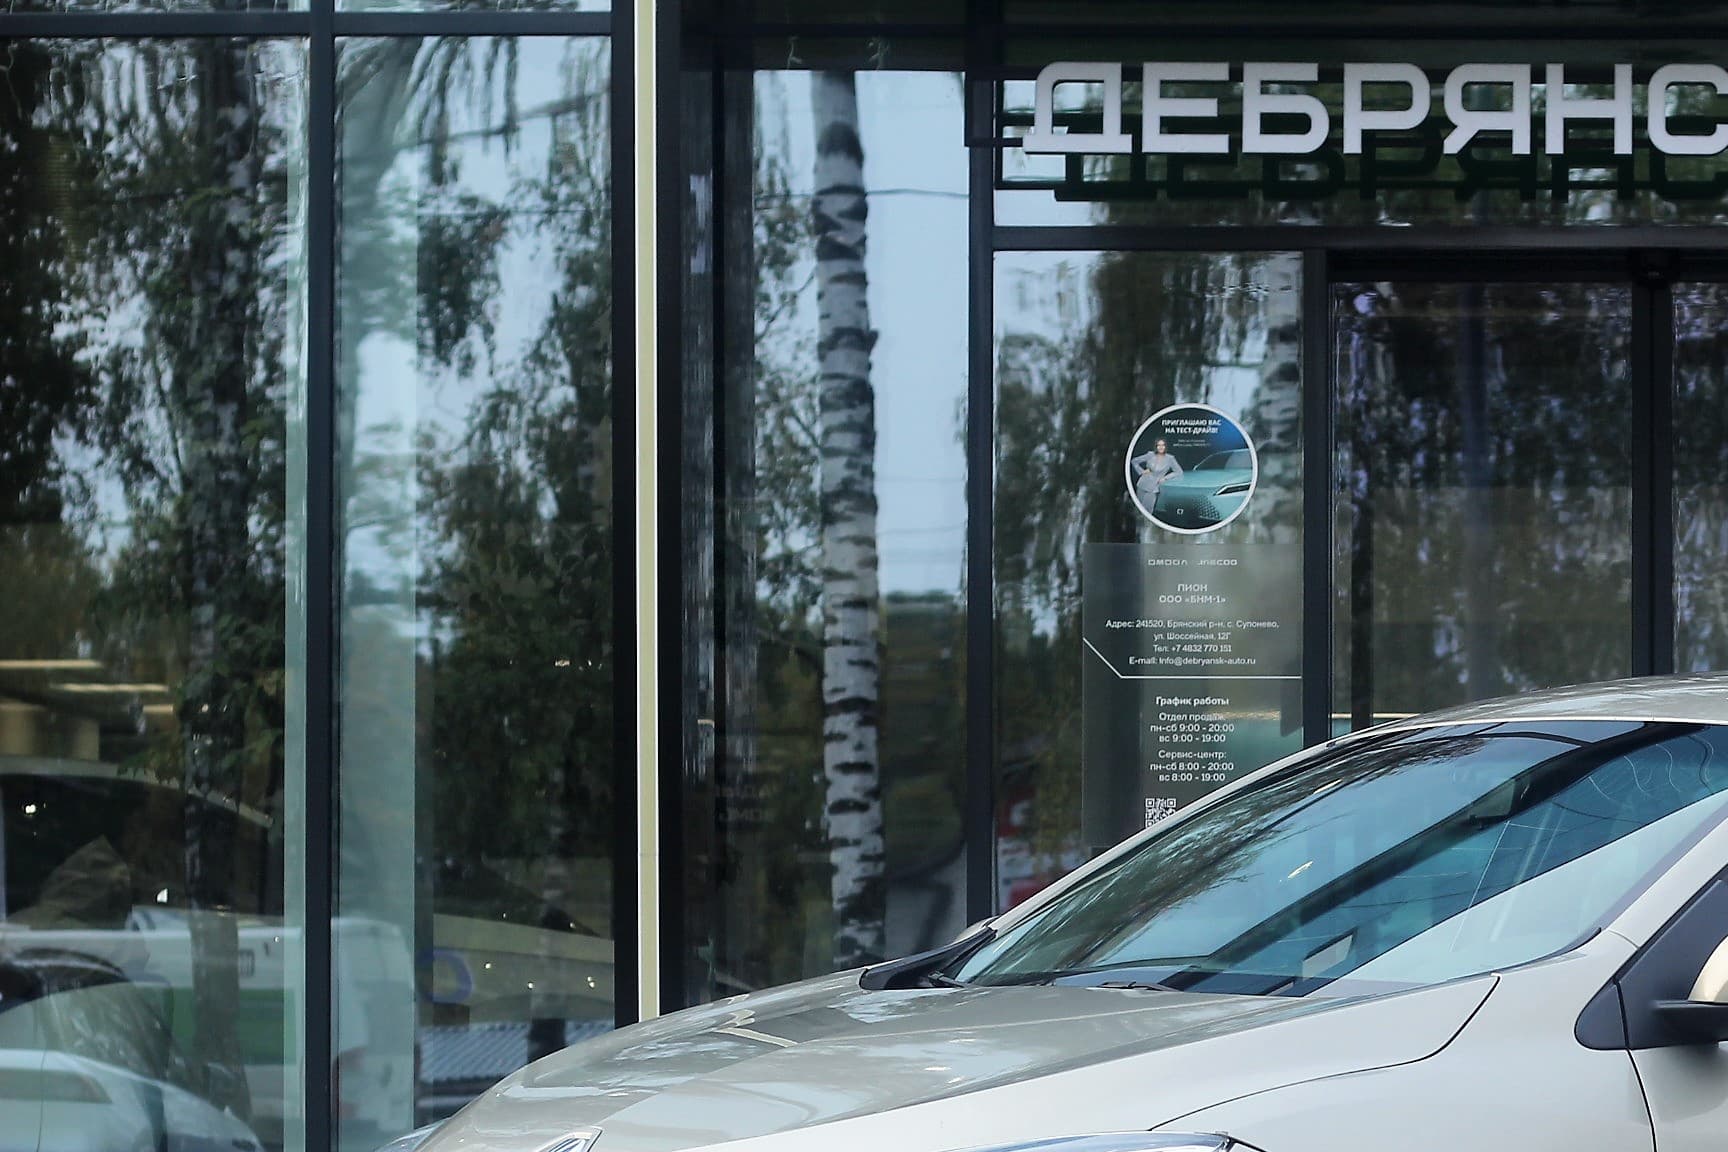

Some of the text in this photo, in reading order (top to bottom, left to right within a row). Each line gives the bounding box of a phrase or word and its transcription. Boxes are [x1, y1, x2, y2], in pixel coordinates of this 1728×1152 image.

[1159, 595, 1182, 603] ООО
[1106, 619, 1135, 629] Адрес:
[1167, 620, 1207, 629] Брянский
[1204, 644, 1218, 652] 770
[1220, 644, 1231, 652] 151
[1156, 696, 1229, 706] График работы
[1159, 712, 1187, 721] Отдел
[1150, 724, 1177, 732] пн-сб
[1179, 723, 1200, 732] 9:00
[1208, 723, 1234, 732] 20:00
[1172, 734, 1193, 742] 9:00
[1201, 734, 1226, 742] 19:00
[1158, 750, 1227, 760] Сервис-центр:
[1150, 762, 1177, 771] пн-сб
[1178, 762, 1199, 771] 8:00
[1207, 762, 1234, 771] 20:00
[1171, 773, 1193, 781] 8:00
[1201, 773, 1226, 781] 19:00
